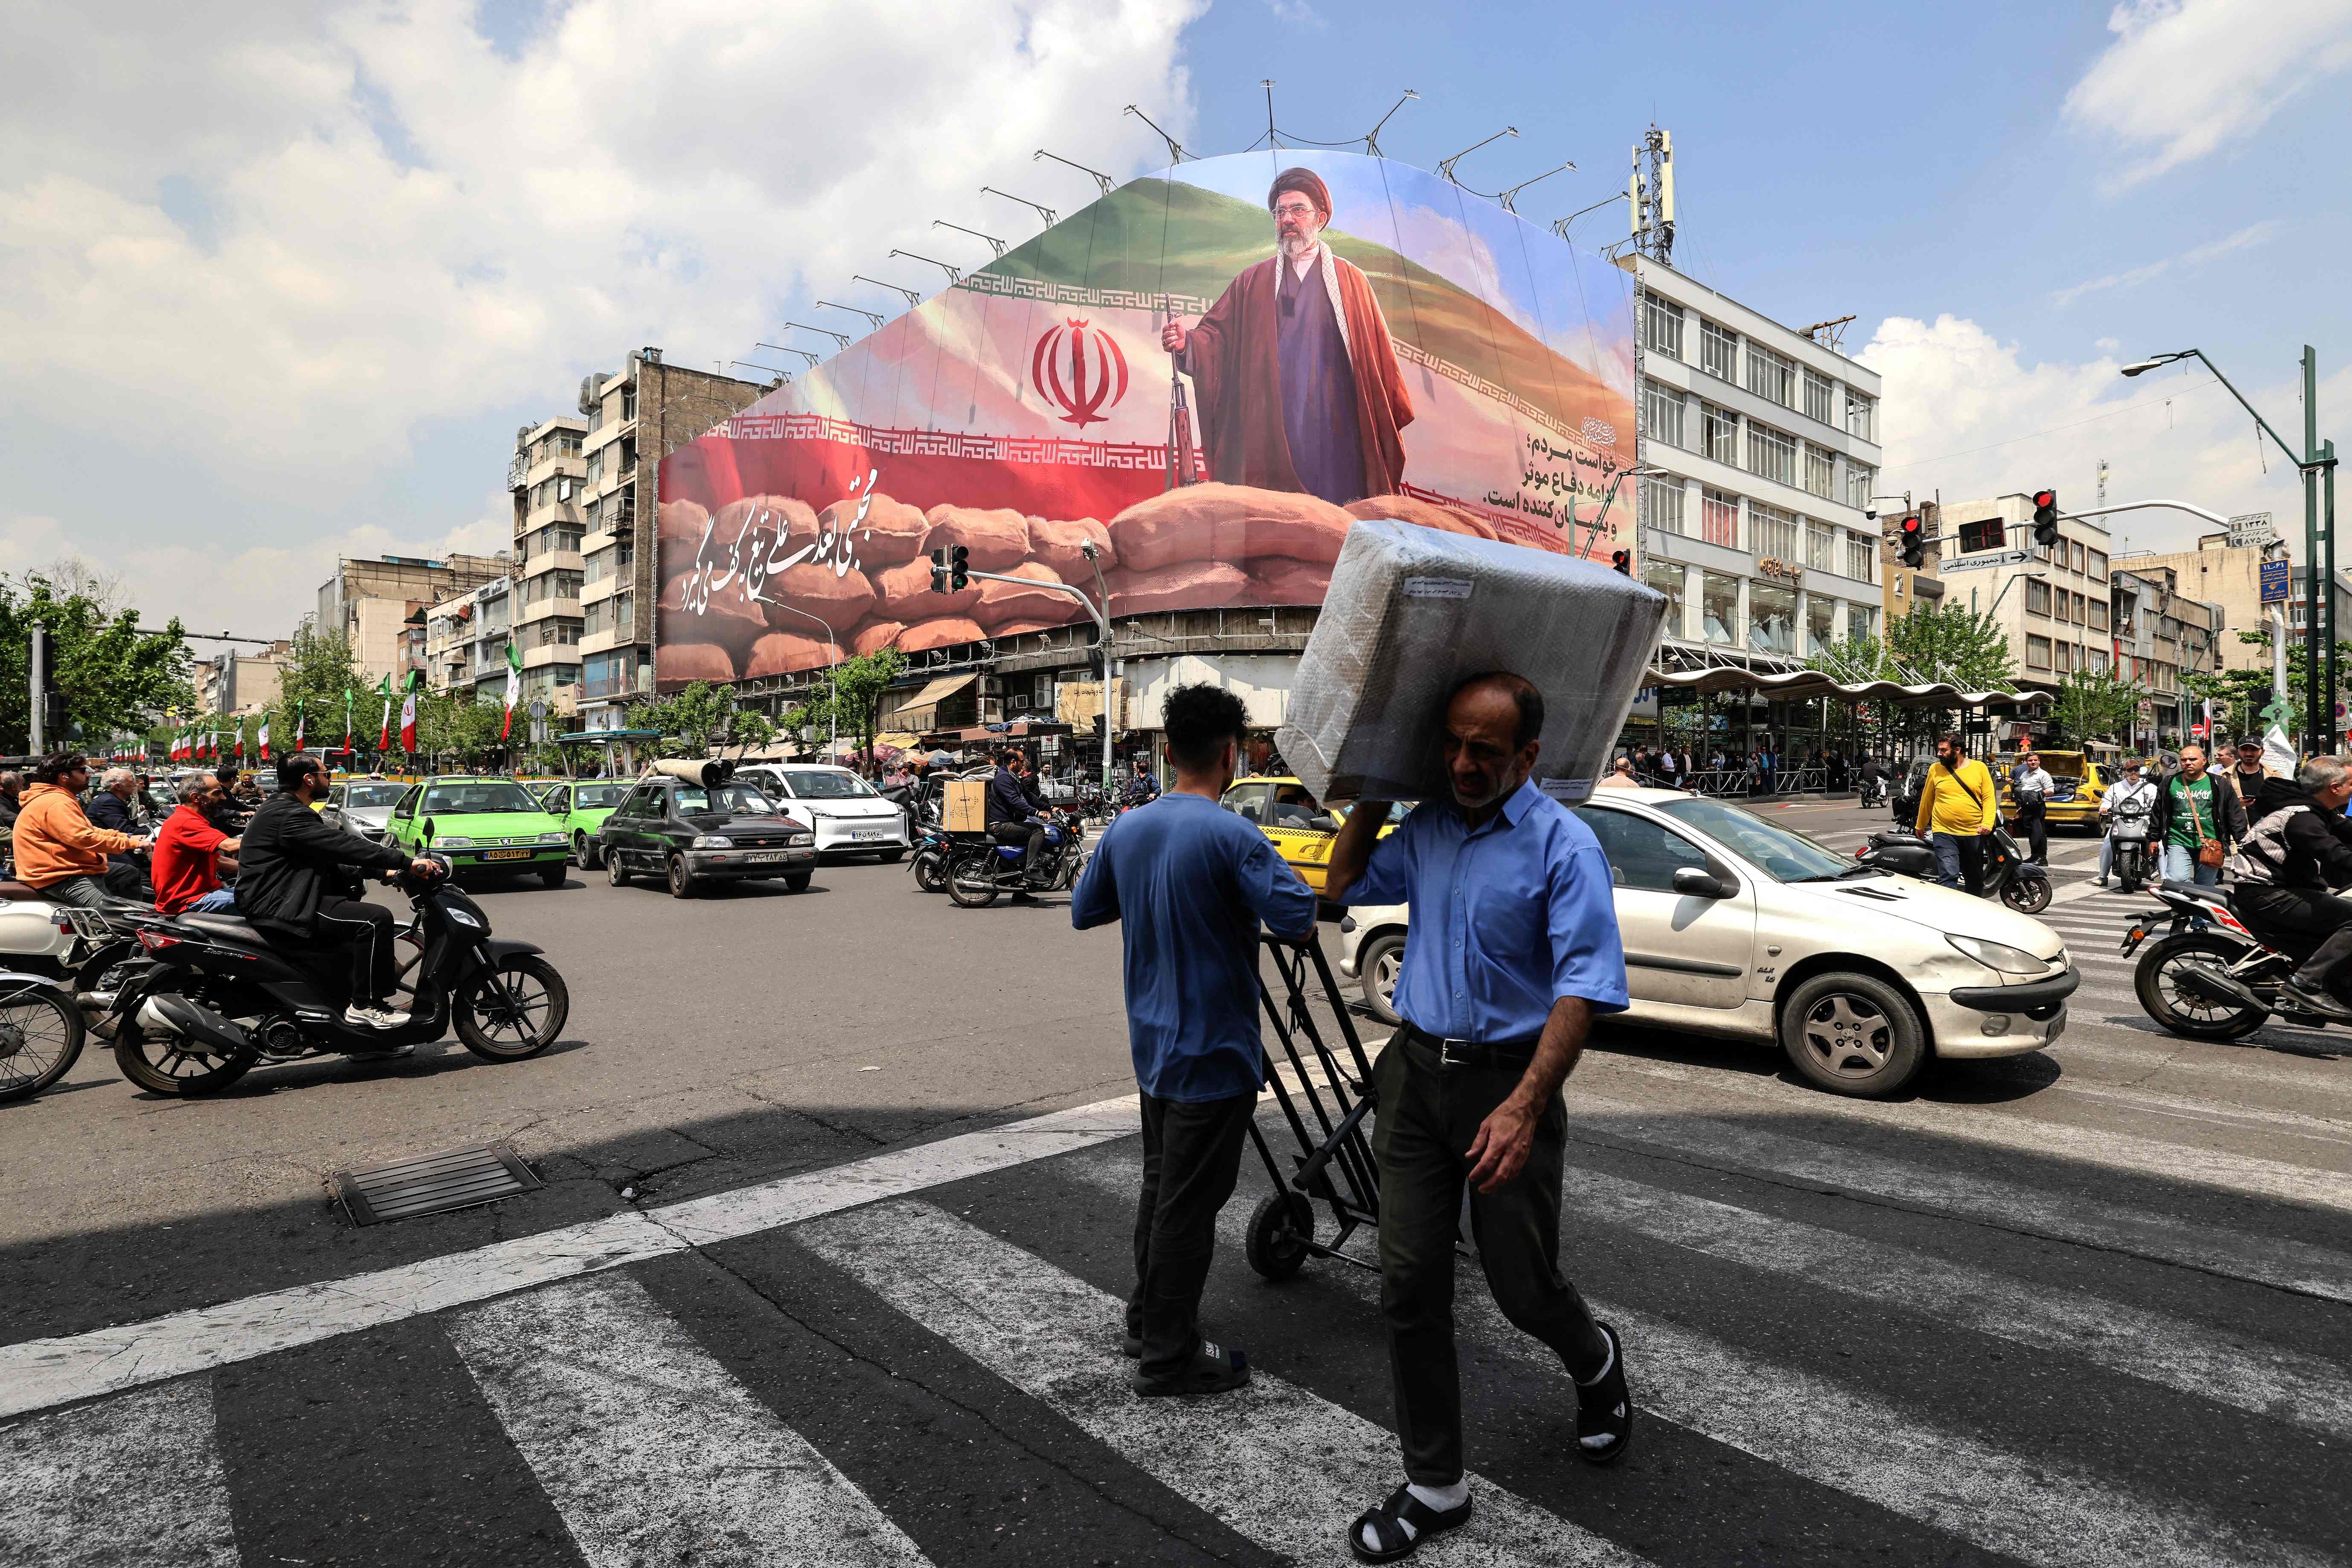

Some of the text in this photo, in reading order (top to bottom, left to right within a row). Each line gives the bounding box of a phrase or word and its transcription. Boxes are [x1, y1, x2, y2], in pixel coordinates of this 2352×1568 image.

[1521, 461, 1549, 491] موثر
[1575, 451, 1616, 478] خواست
[1552, 470, 1584, 496] دفاع
[836, 468, 878, 578] مجتبی
[1523, 498, 1554, 518] کننده
[711, 501, 756, 592] کف
[766, 513, 817, 575] علی
[810, 515, 838, 570] بعد
[1611, 522, 1617, 542] و
[747, 509, 770, 602] تیغ
[1944, 558, 1999, 570] جمهوری اسلامی
[737, 567, 748, 604] به
